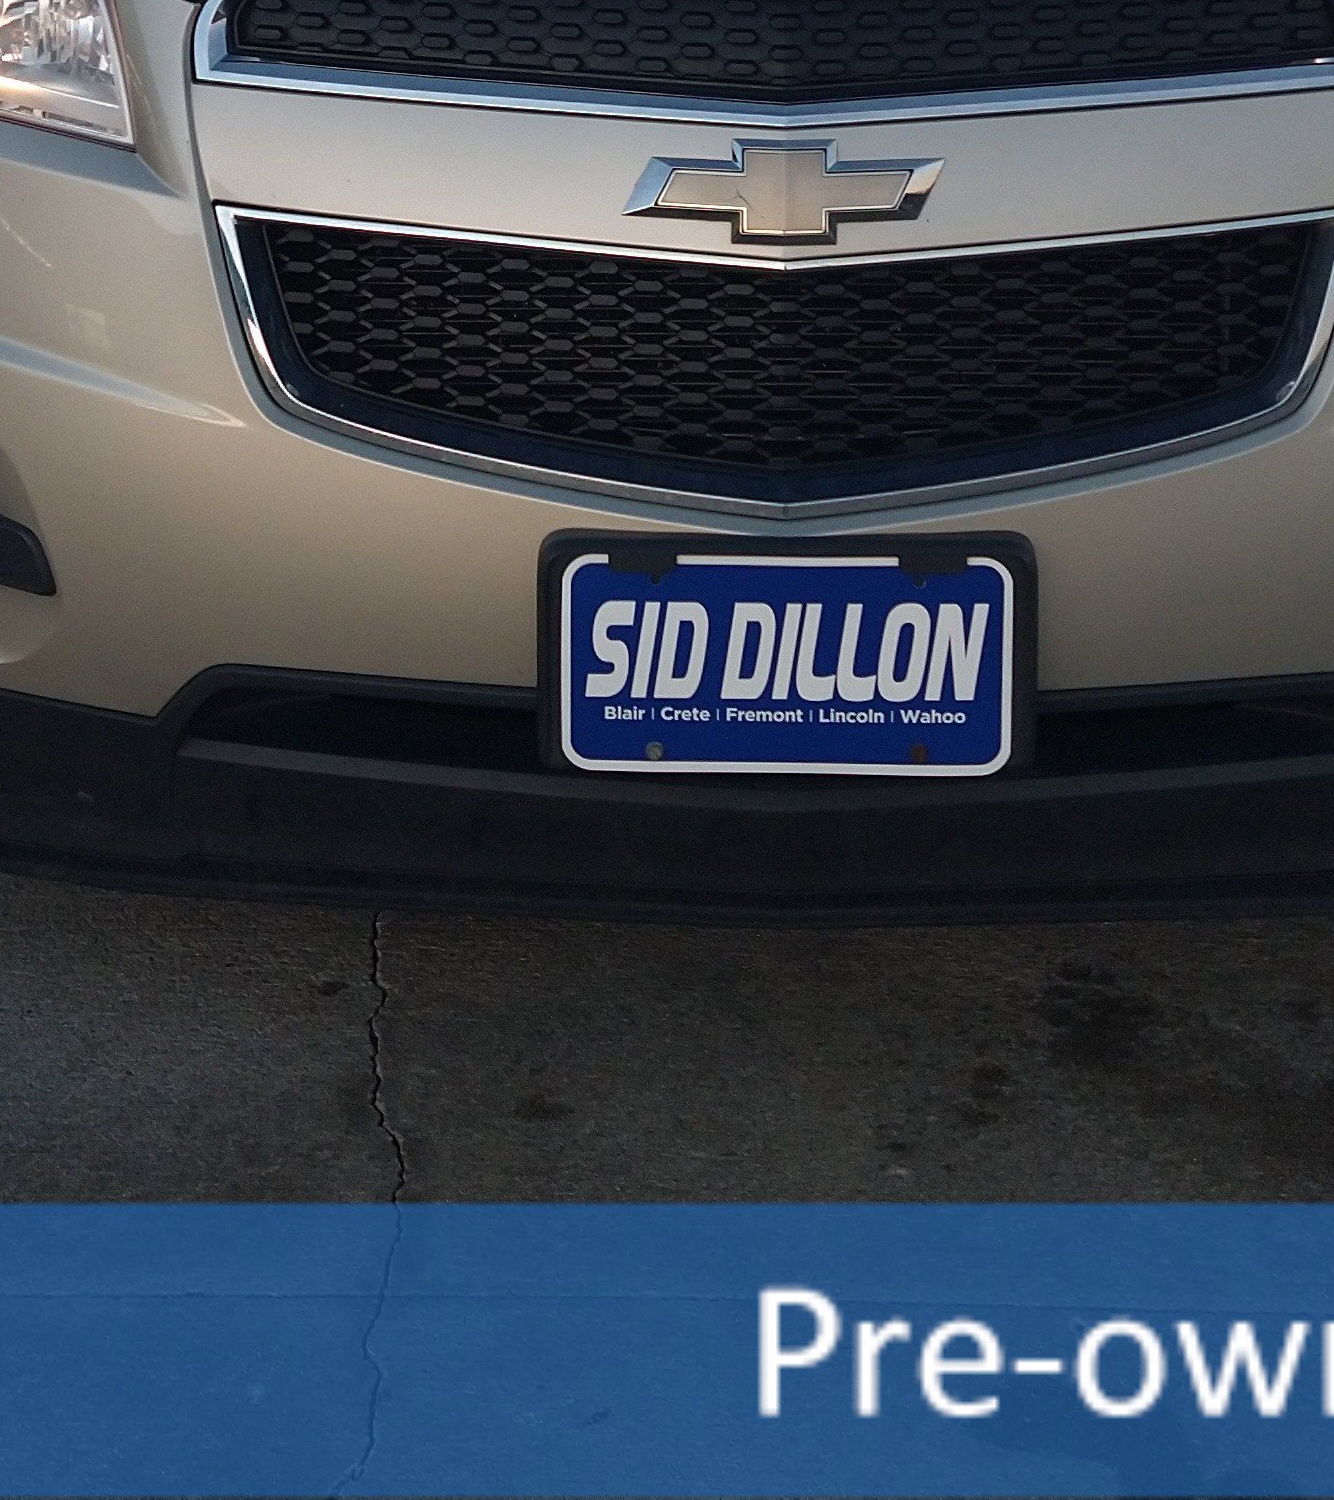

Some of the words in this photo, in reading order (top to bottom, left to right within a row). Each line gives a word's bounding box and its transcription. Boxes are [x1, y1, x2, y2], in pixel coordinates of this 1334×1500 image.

[584, 600, 709, 699] SID
[720, 602, 990, 702] DILLON
[604, 705, 647, 721] Blair
[660, 706, 711, 722] Crete
[725, 707, 804, 723] Fremont
[818, 708, 885, 724] Lincoln
[900, 708, 967, 724] Wahoo
